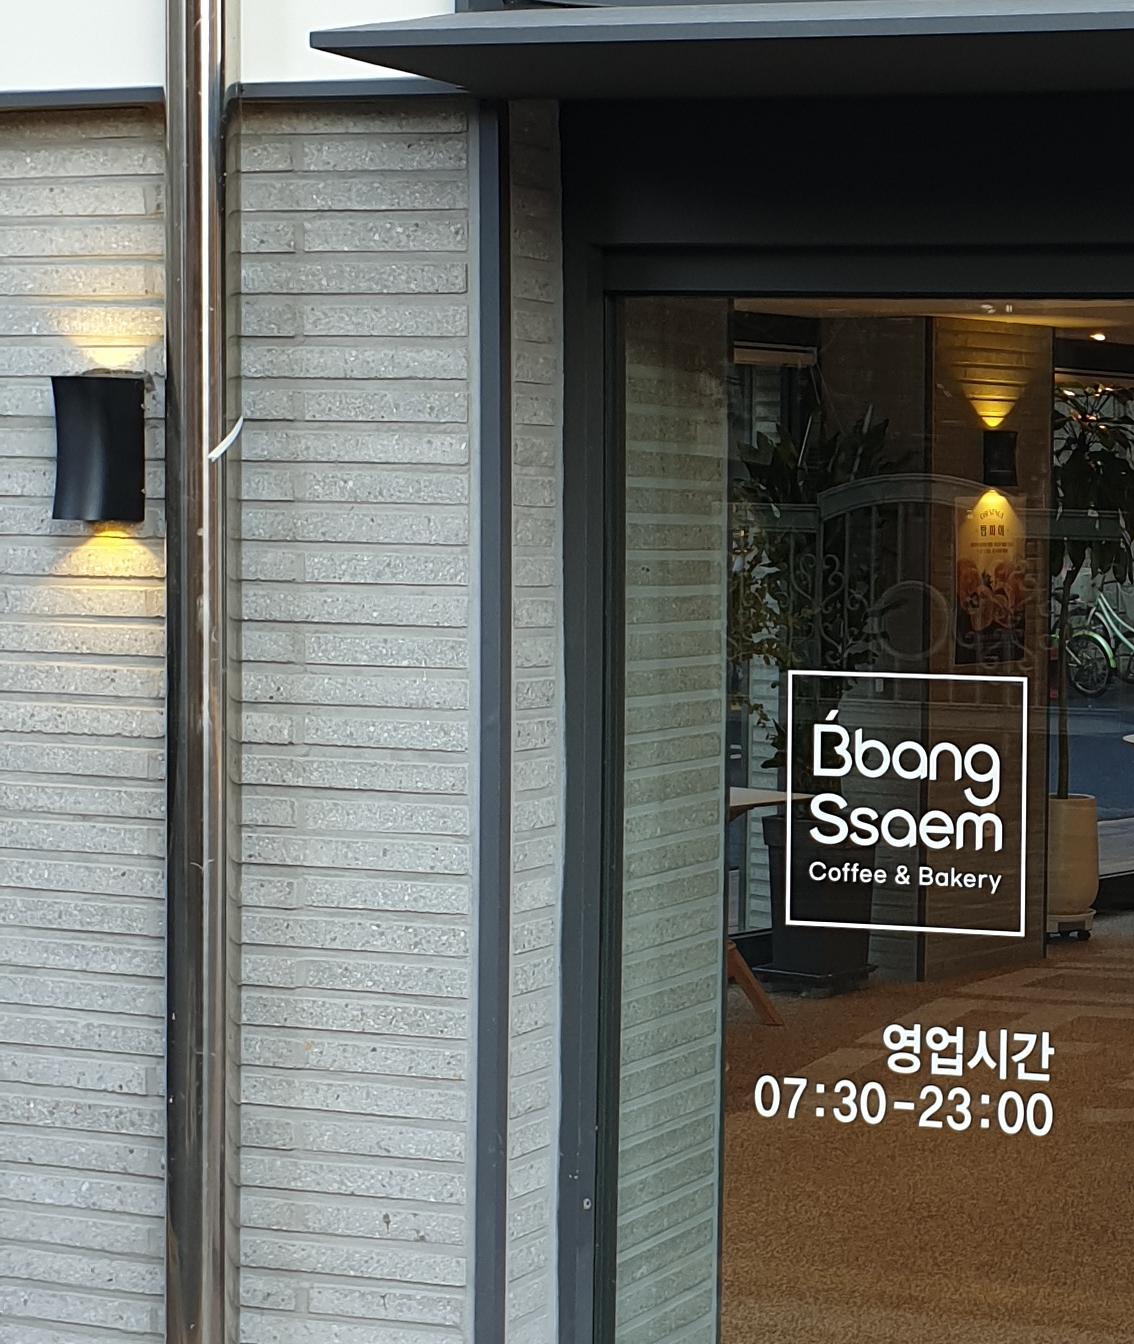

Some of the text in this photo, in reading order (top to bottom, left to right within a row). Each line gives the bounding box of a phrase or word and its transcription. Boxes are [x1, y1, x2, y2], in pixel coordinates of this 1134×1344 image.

[808, 793, 1004, 853] Ssaem
[808, 860, 1003, 895] Coffee & Bakery
[882, 1022, 1055, 1084] 영업시간
[753, 1073, 1054, 1138] 07:30-23:00
